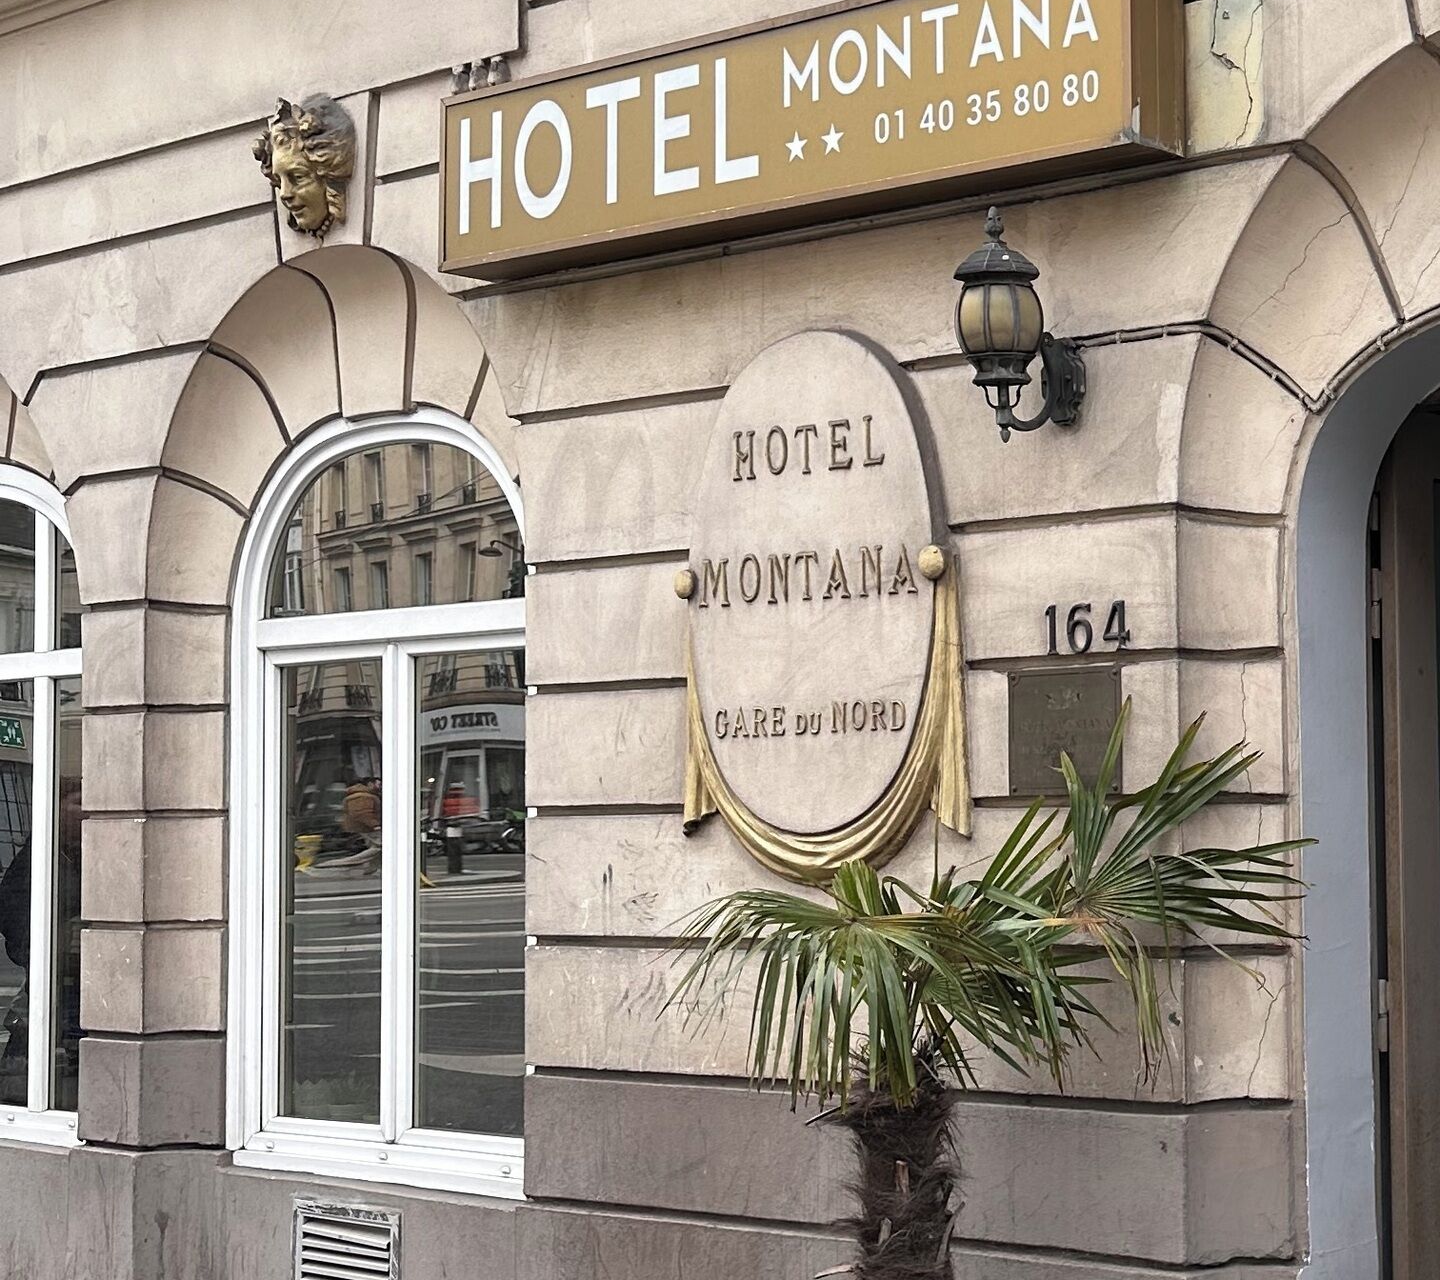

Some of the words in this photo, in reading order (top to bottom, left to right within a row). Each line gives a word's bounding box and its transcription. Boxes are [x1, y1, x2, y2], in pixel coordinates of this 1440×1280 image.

[874, 109, 904, 144] 01
[919, 100, 954, 134] 40
[966, 89, 1001, 126] 35
[1013, 80, 1049, 116] 80
[1062, 70, 1099, 107] 80
[459, 57, 760, 235] HOTEL
[732, 415, 885, 482] HOTEL
[697, 543, 918, 608] MONTANA
[1044, 600, 1131, 656] 164
[715, 705, 786, 738] GARE
[830, 698, 907, 734] NORD
